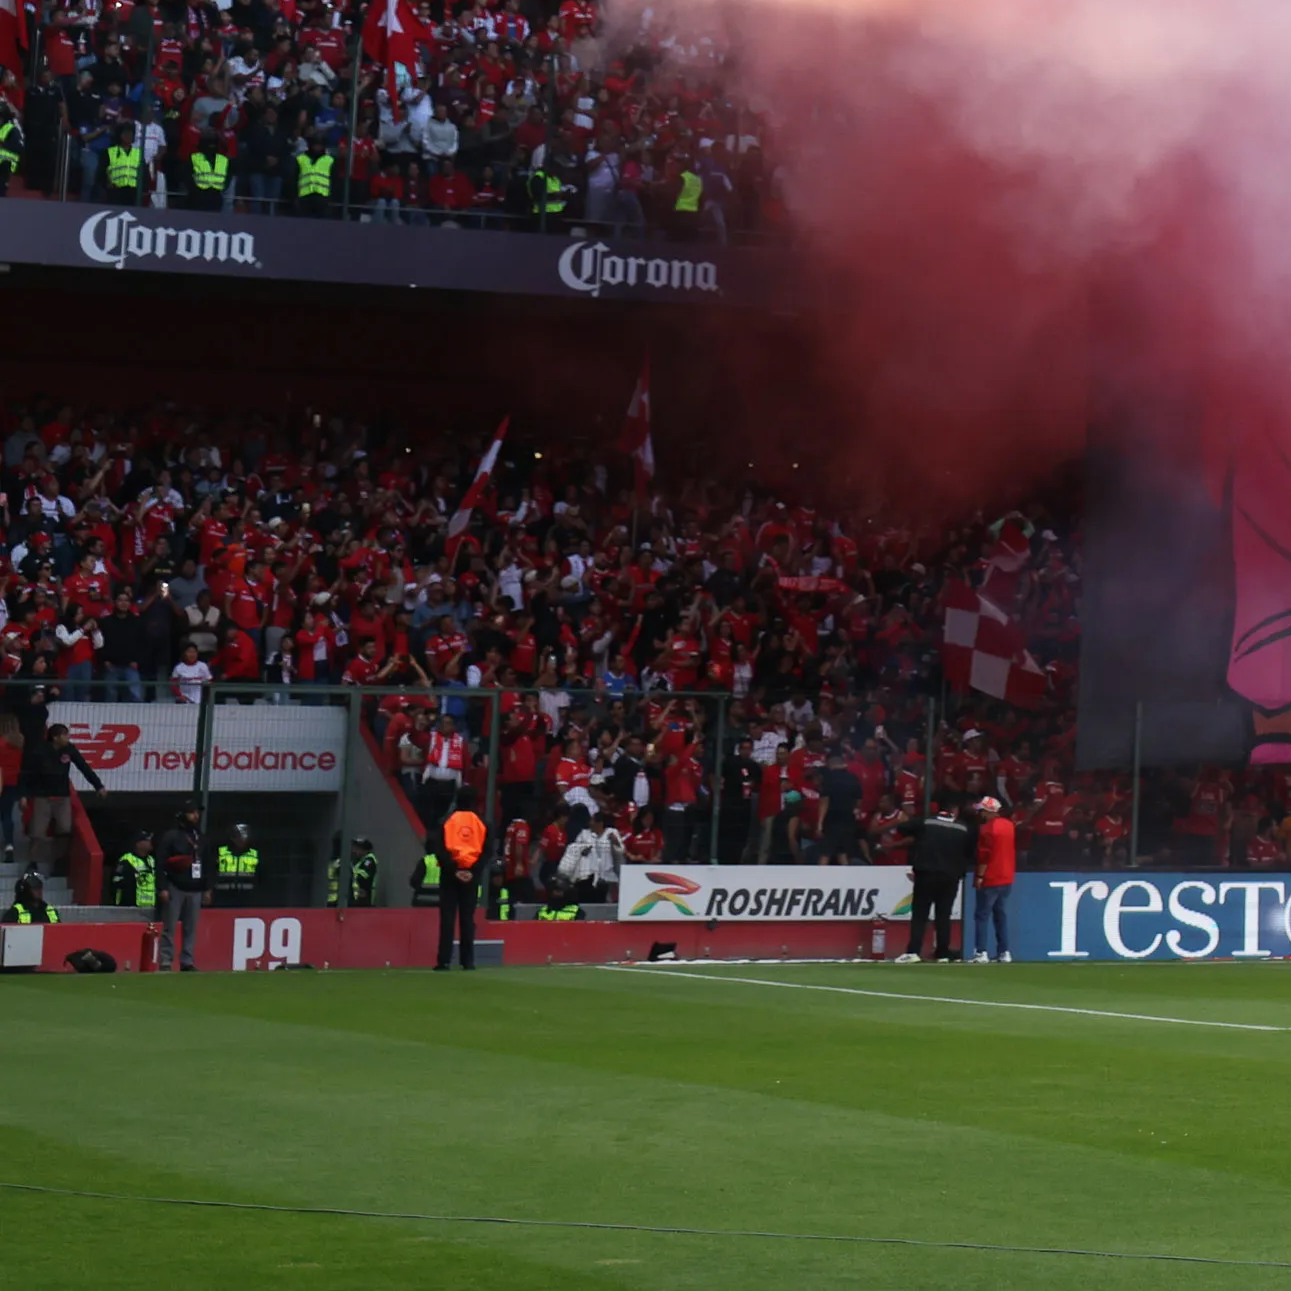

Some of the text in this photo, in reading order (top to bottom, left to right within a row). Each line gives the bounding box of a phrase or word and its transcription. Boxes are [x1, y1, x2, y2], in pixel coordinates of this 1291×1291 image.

[80, 210, 257, 269] Corona
[558, 242, 718, 297] Corona
[144, 746, 336, 771] new balance
[705, 887, 880, 917] ROSHFRANS
[233, 918, 301, 971] P9
